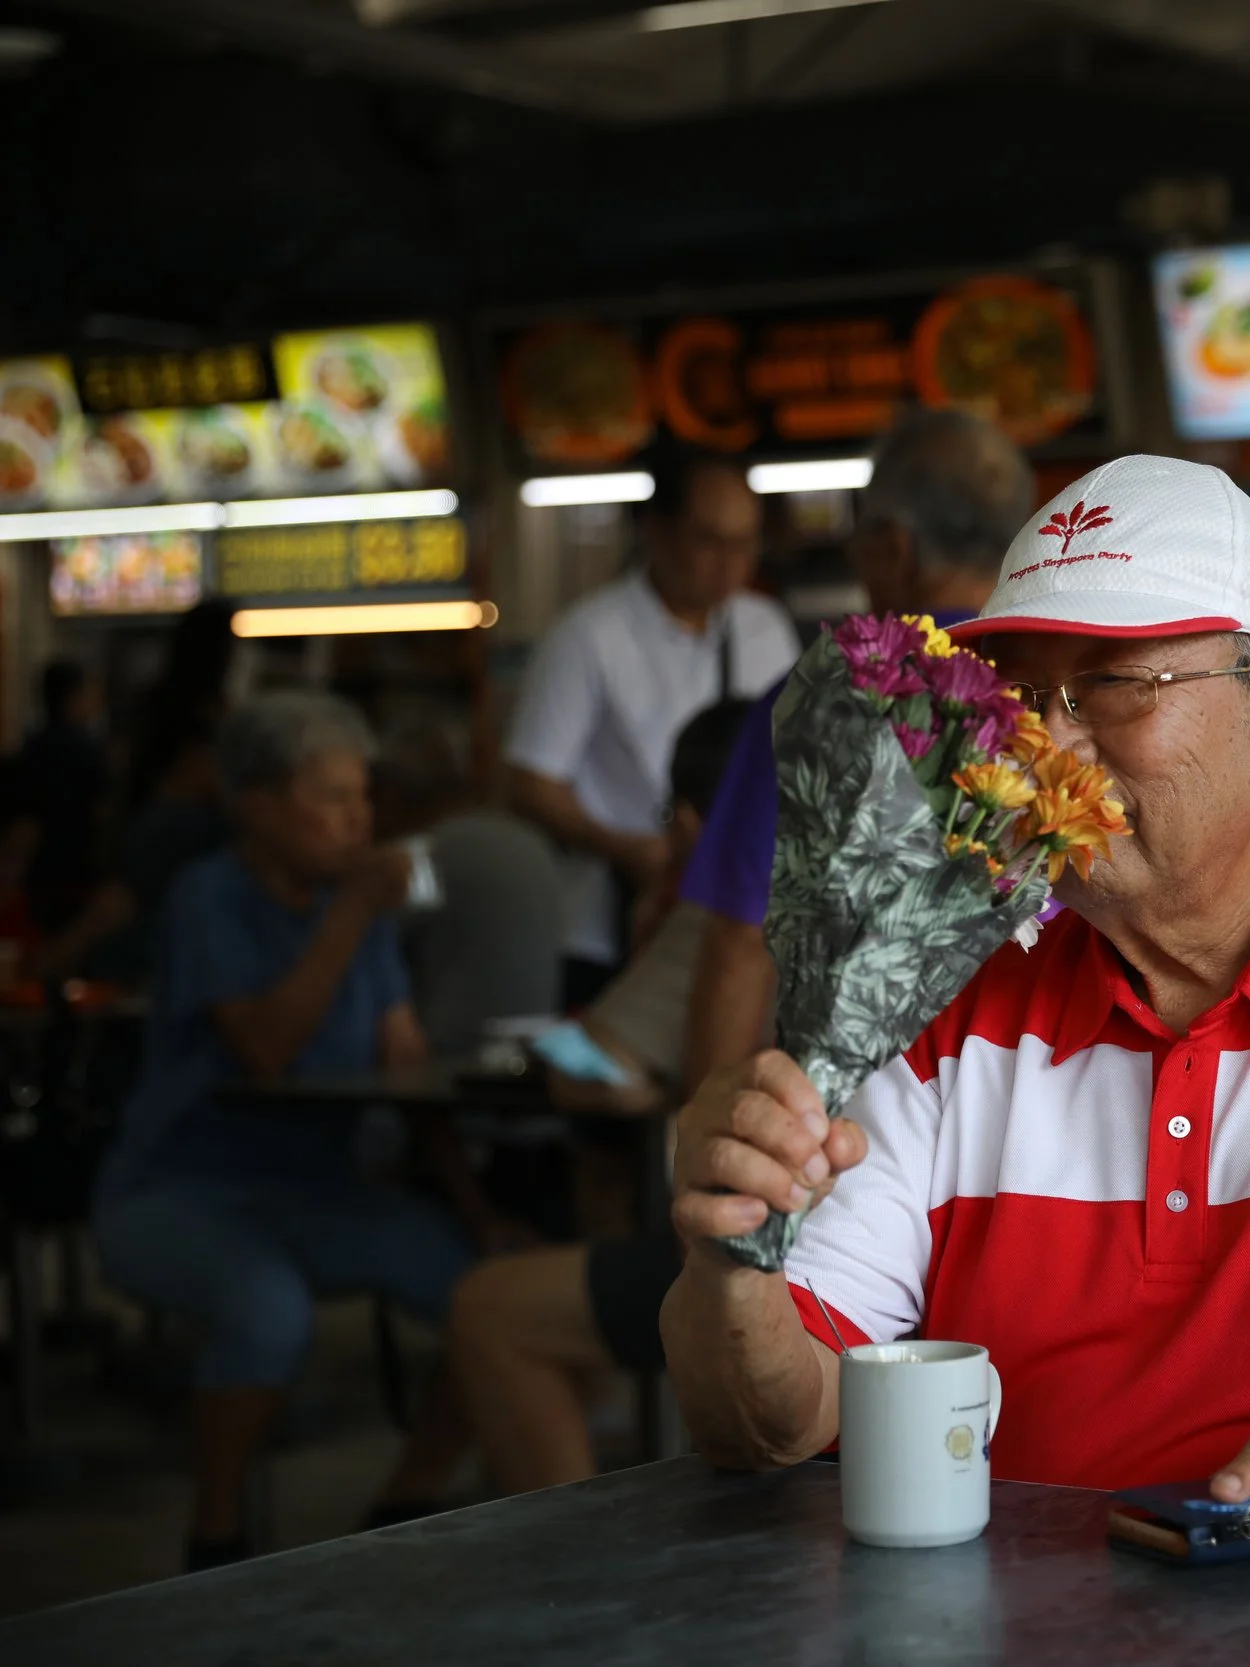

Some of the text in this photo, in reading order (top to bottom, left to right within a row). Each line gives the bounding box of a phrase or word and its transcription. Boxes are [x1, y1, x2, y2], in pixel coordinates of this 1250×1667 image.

[1007, 551, 1133, 582] Progress Singapore Party
